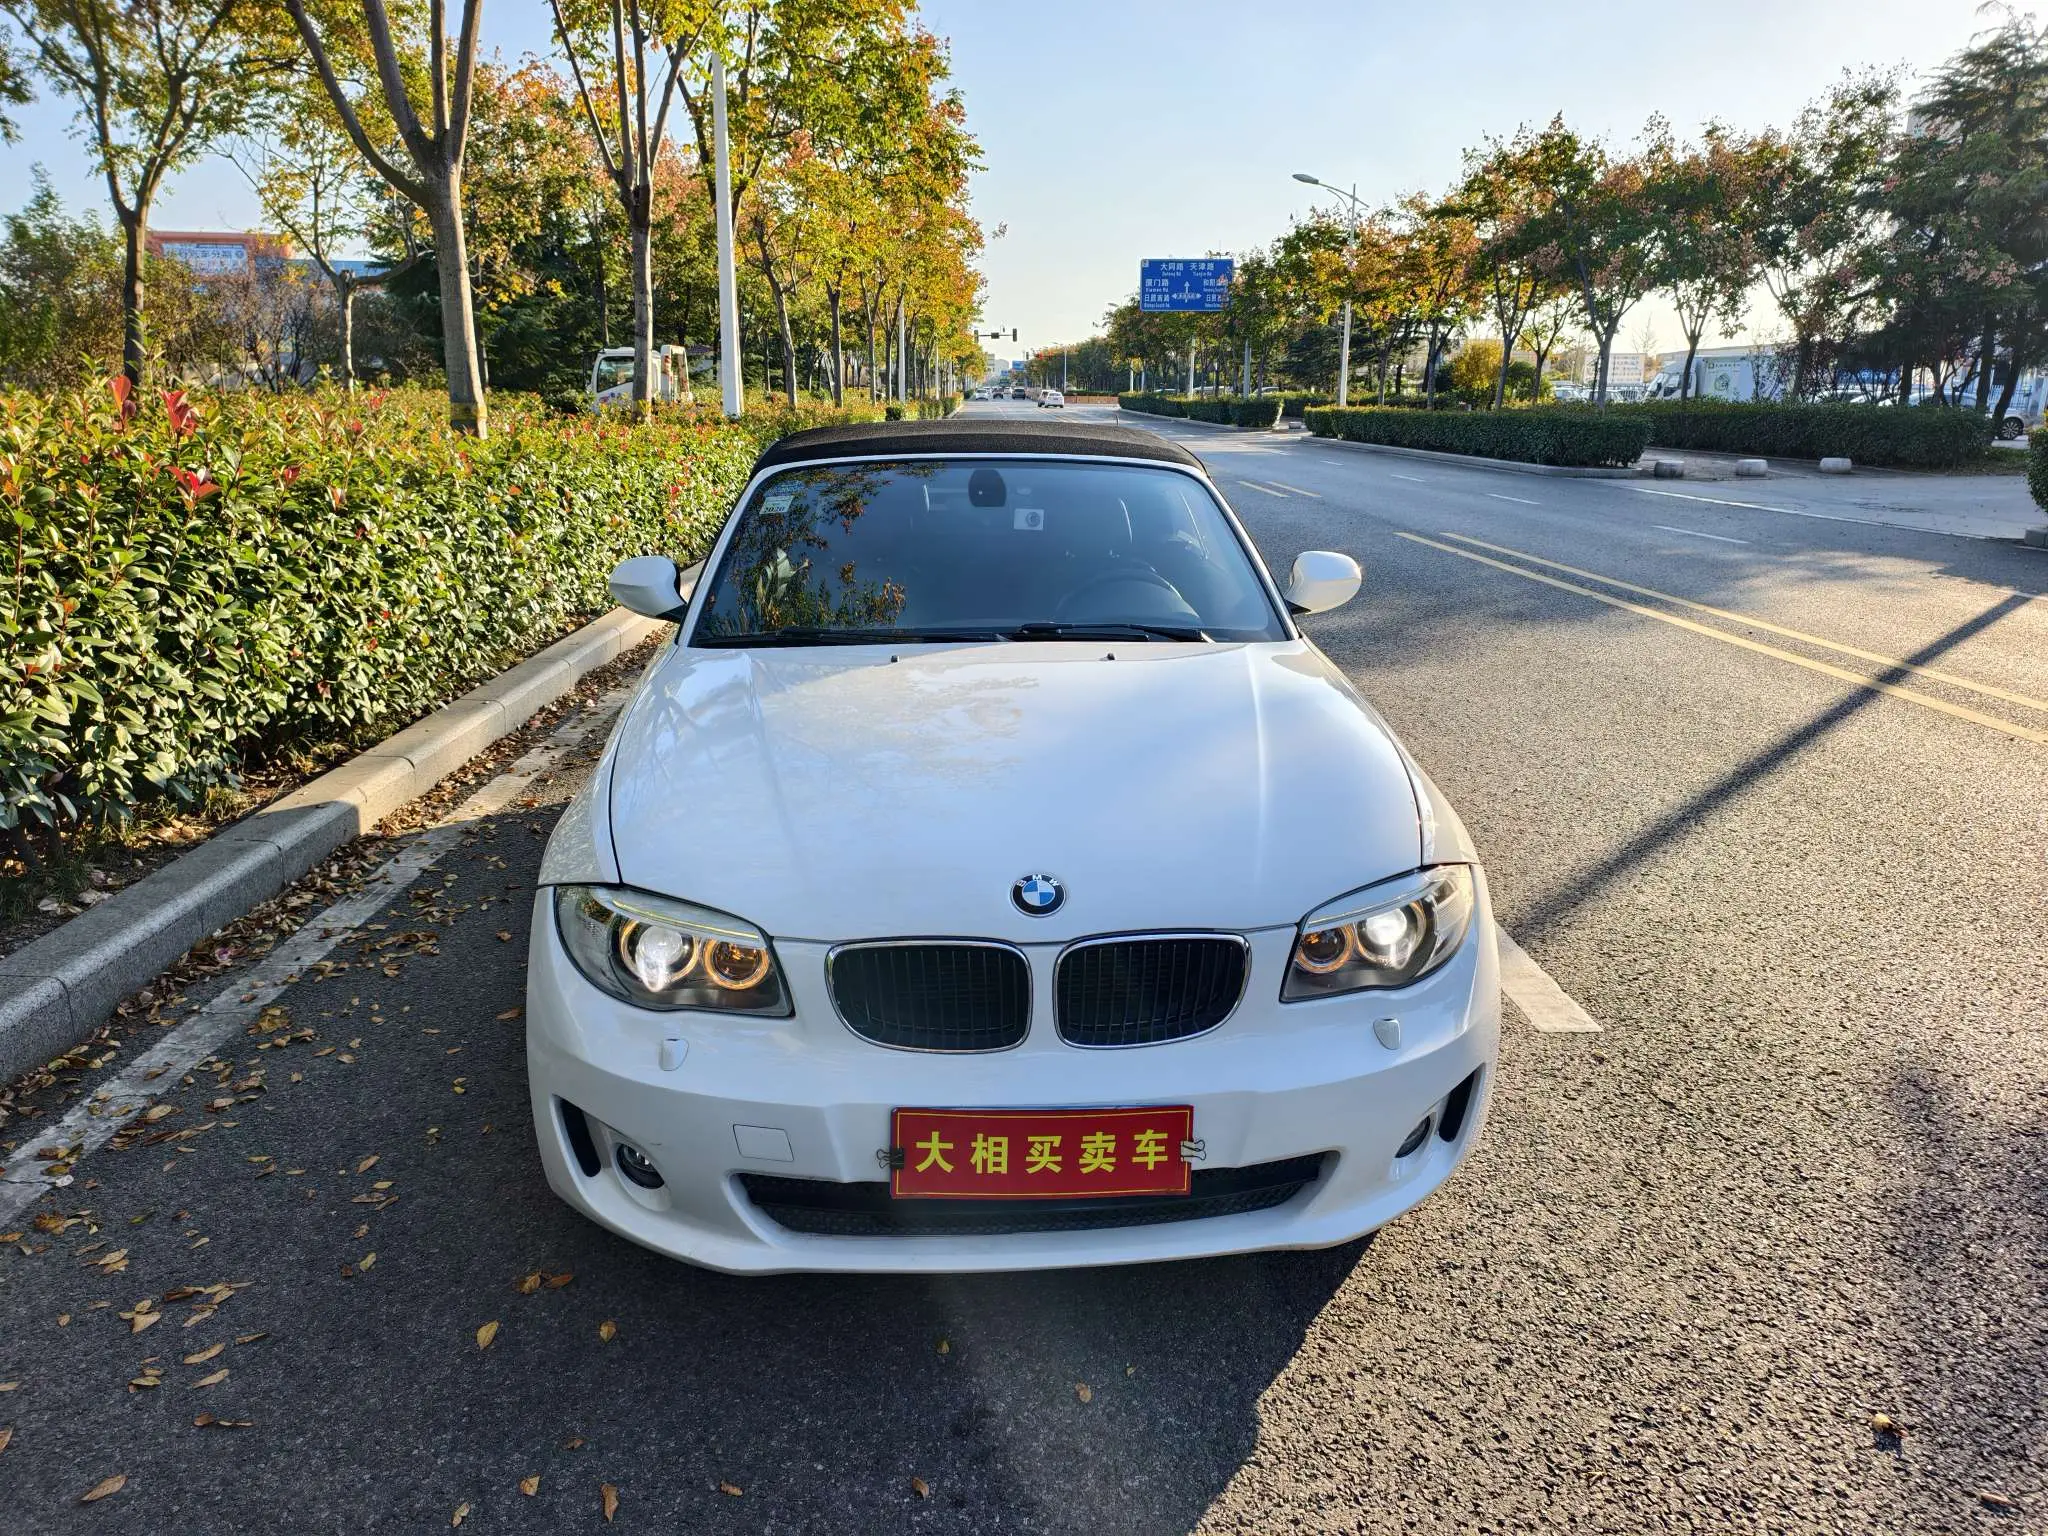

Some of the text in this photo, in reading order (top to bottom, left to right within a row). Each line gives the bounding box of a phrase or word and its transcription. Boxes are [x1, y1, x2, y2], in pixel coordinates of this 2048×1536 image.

[1016, 874, 1060, 888] BMW
[914, 1128, 1169, 1175] 大相买卖车
